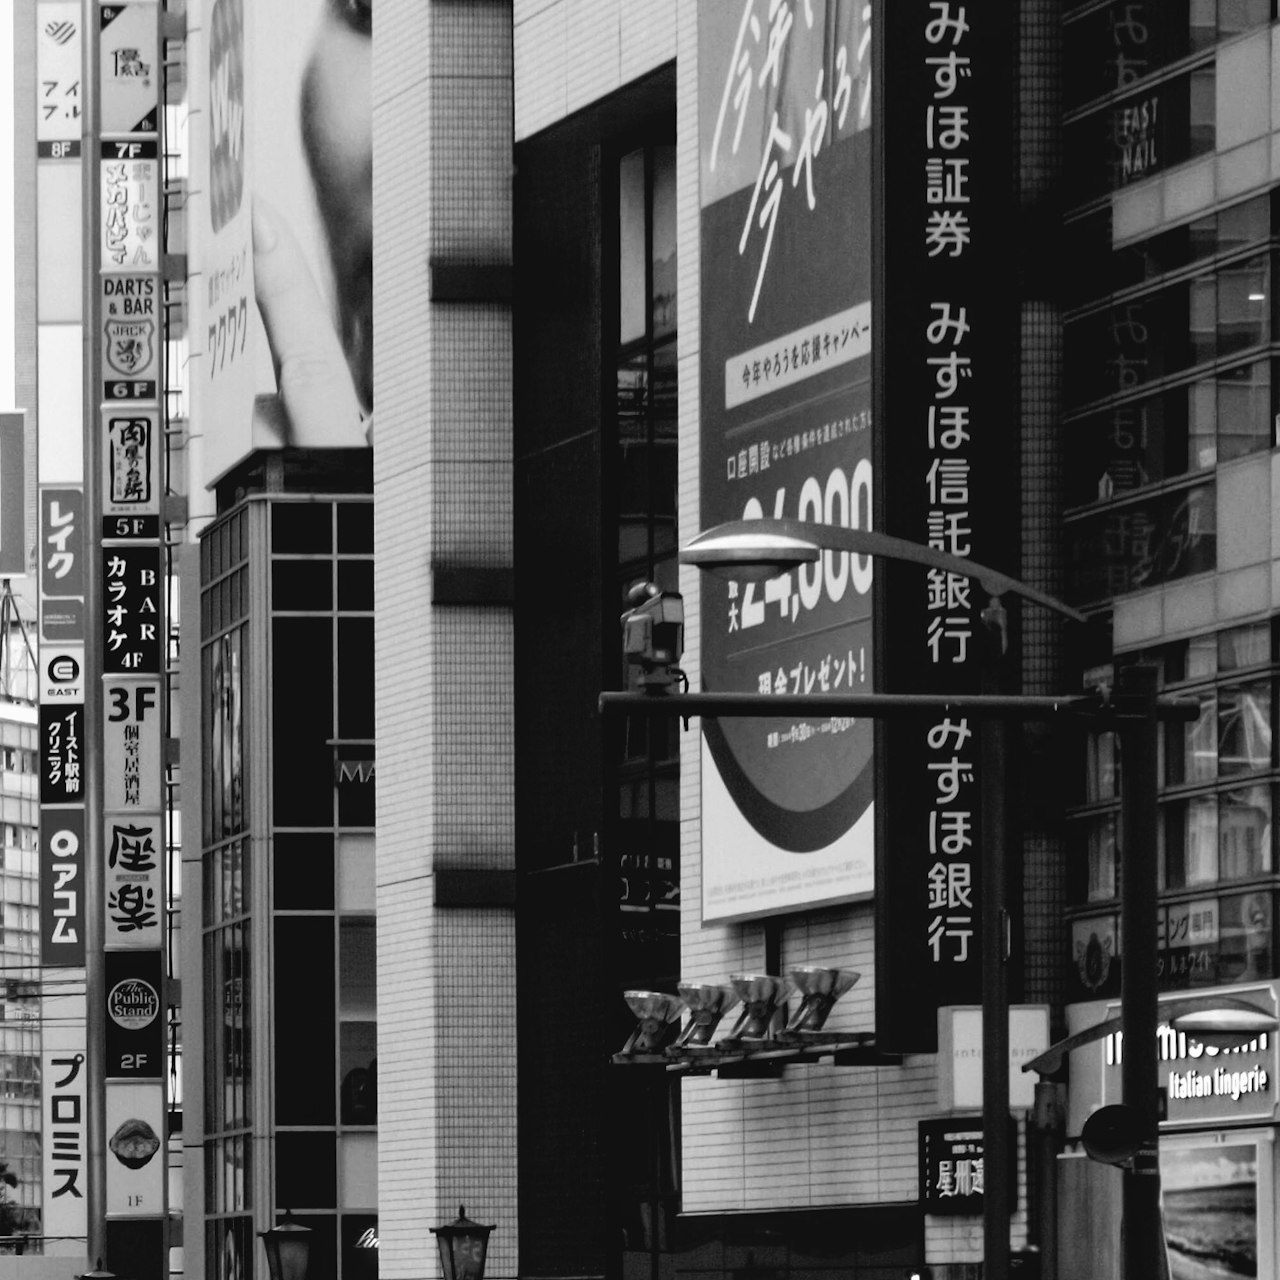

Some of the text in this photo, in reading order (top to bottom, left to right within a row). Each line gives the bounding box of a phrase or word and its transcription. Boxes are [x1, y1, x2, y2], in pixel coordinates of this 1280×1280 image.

[925, 1, 972, 257] みずほ証券
[51, 142, 71, 158] 8F
[115, 142, 142, 158] 7F
[104, 279, 154, 296] DARTS
[109, 298, 154, 314] & BAR
[925, 303, 973, 664] みずほ信託銀行
[116, 518, 145, 535] 5F
[48, 501, 74, 579] レイク
[107, 556, 128, 650] カラオケ
[121, 652, 143, 667] 4F
[108, 687, 156, 722] 3F
[48, 722, 61, 785] クリニック
[928, 717, 974, 962] みずほ銀行
[114, 992, 155, 1004] Public
[114, 1004, 153, 1016] Stand
[121, 1054, 147, 1068] 2F
[1168, 1064, 1267, 1100] Italian lingerie
[51, 1054, 84, 1198] プロミス
